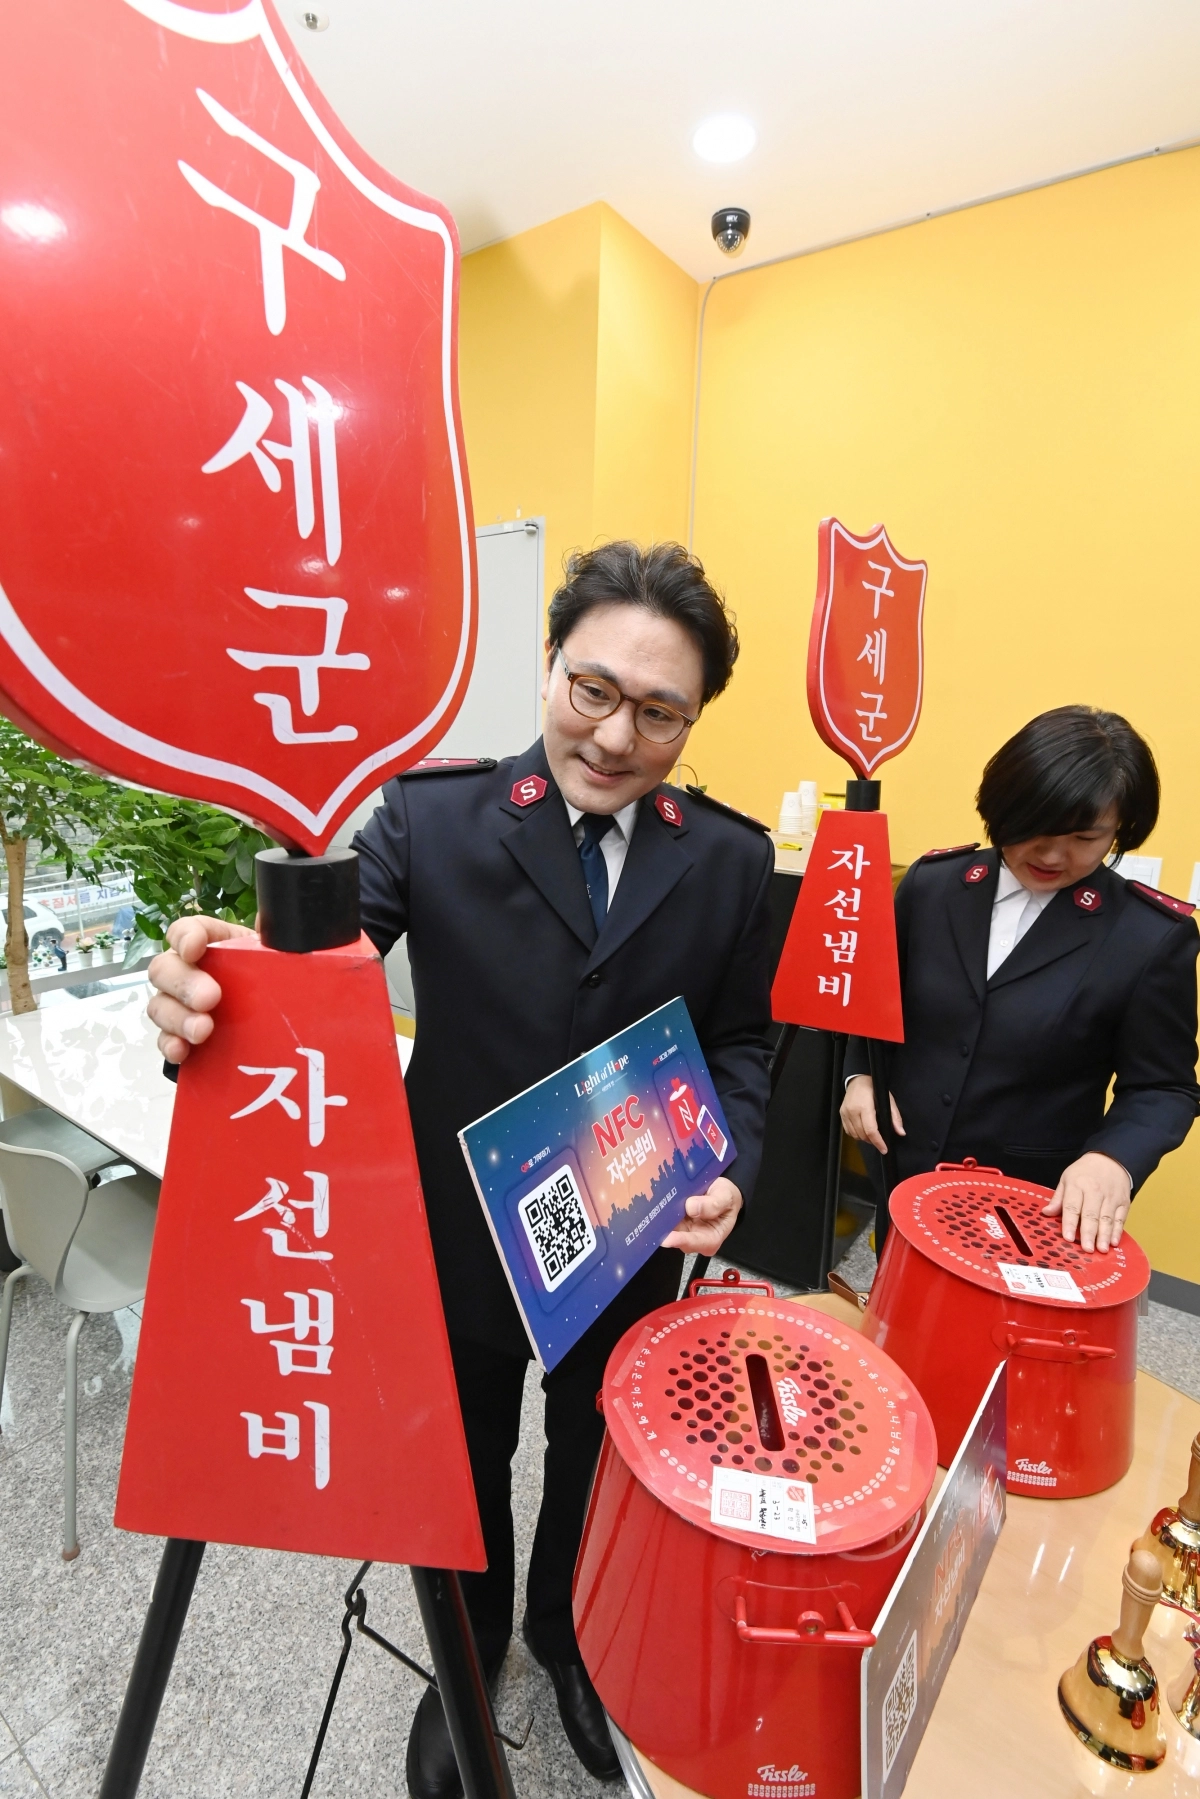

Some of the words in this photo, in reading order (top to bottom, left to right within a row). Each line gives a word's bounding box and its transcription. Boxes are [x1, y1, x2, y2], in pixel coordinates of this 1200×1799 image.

[178, 87, 370, 745] 구세군
[855, 560, 894, 742] 구세군
[520, 781, 537, 800] S
[663, 801, 676, 819] S
[969, 866, 983, 881] S
[1080, 890, 1096, 907] S
[818, 844, 871, 1007] 자선냄비
[591, 1094, 645, 1159] NFC
[606, 1128, 657, 1185] 자선냄비
[230, 1047, 348, 1490] 자선냄비
[776, 1376, 807, 1427] Fissler
[1015, 1458, 1052, 1475] Fissler
[757, 1764, 808, 1782] Fissler
